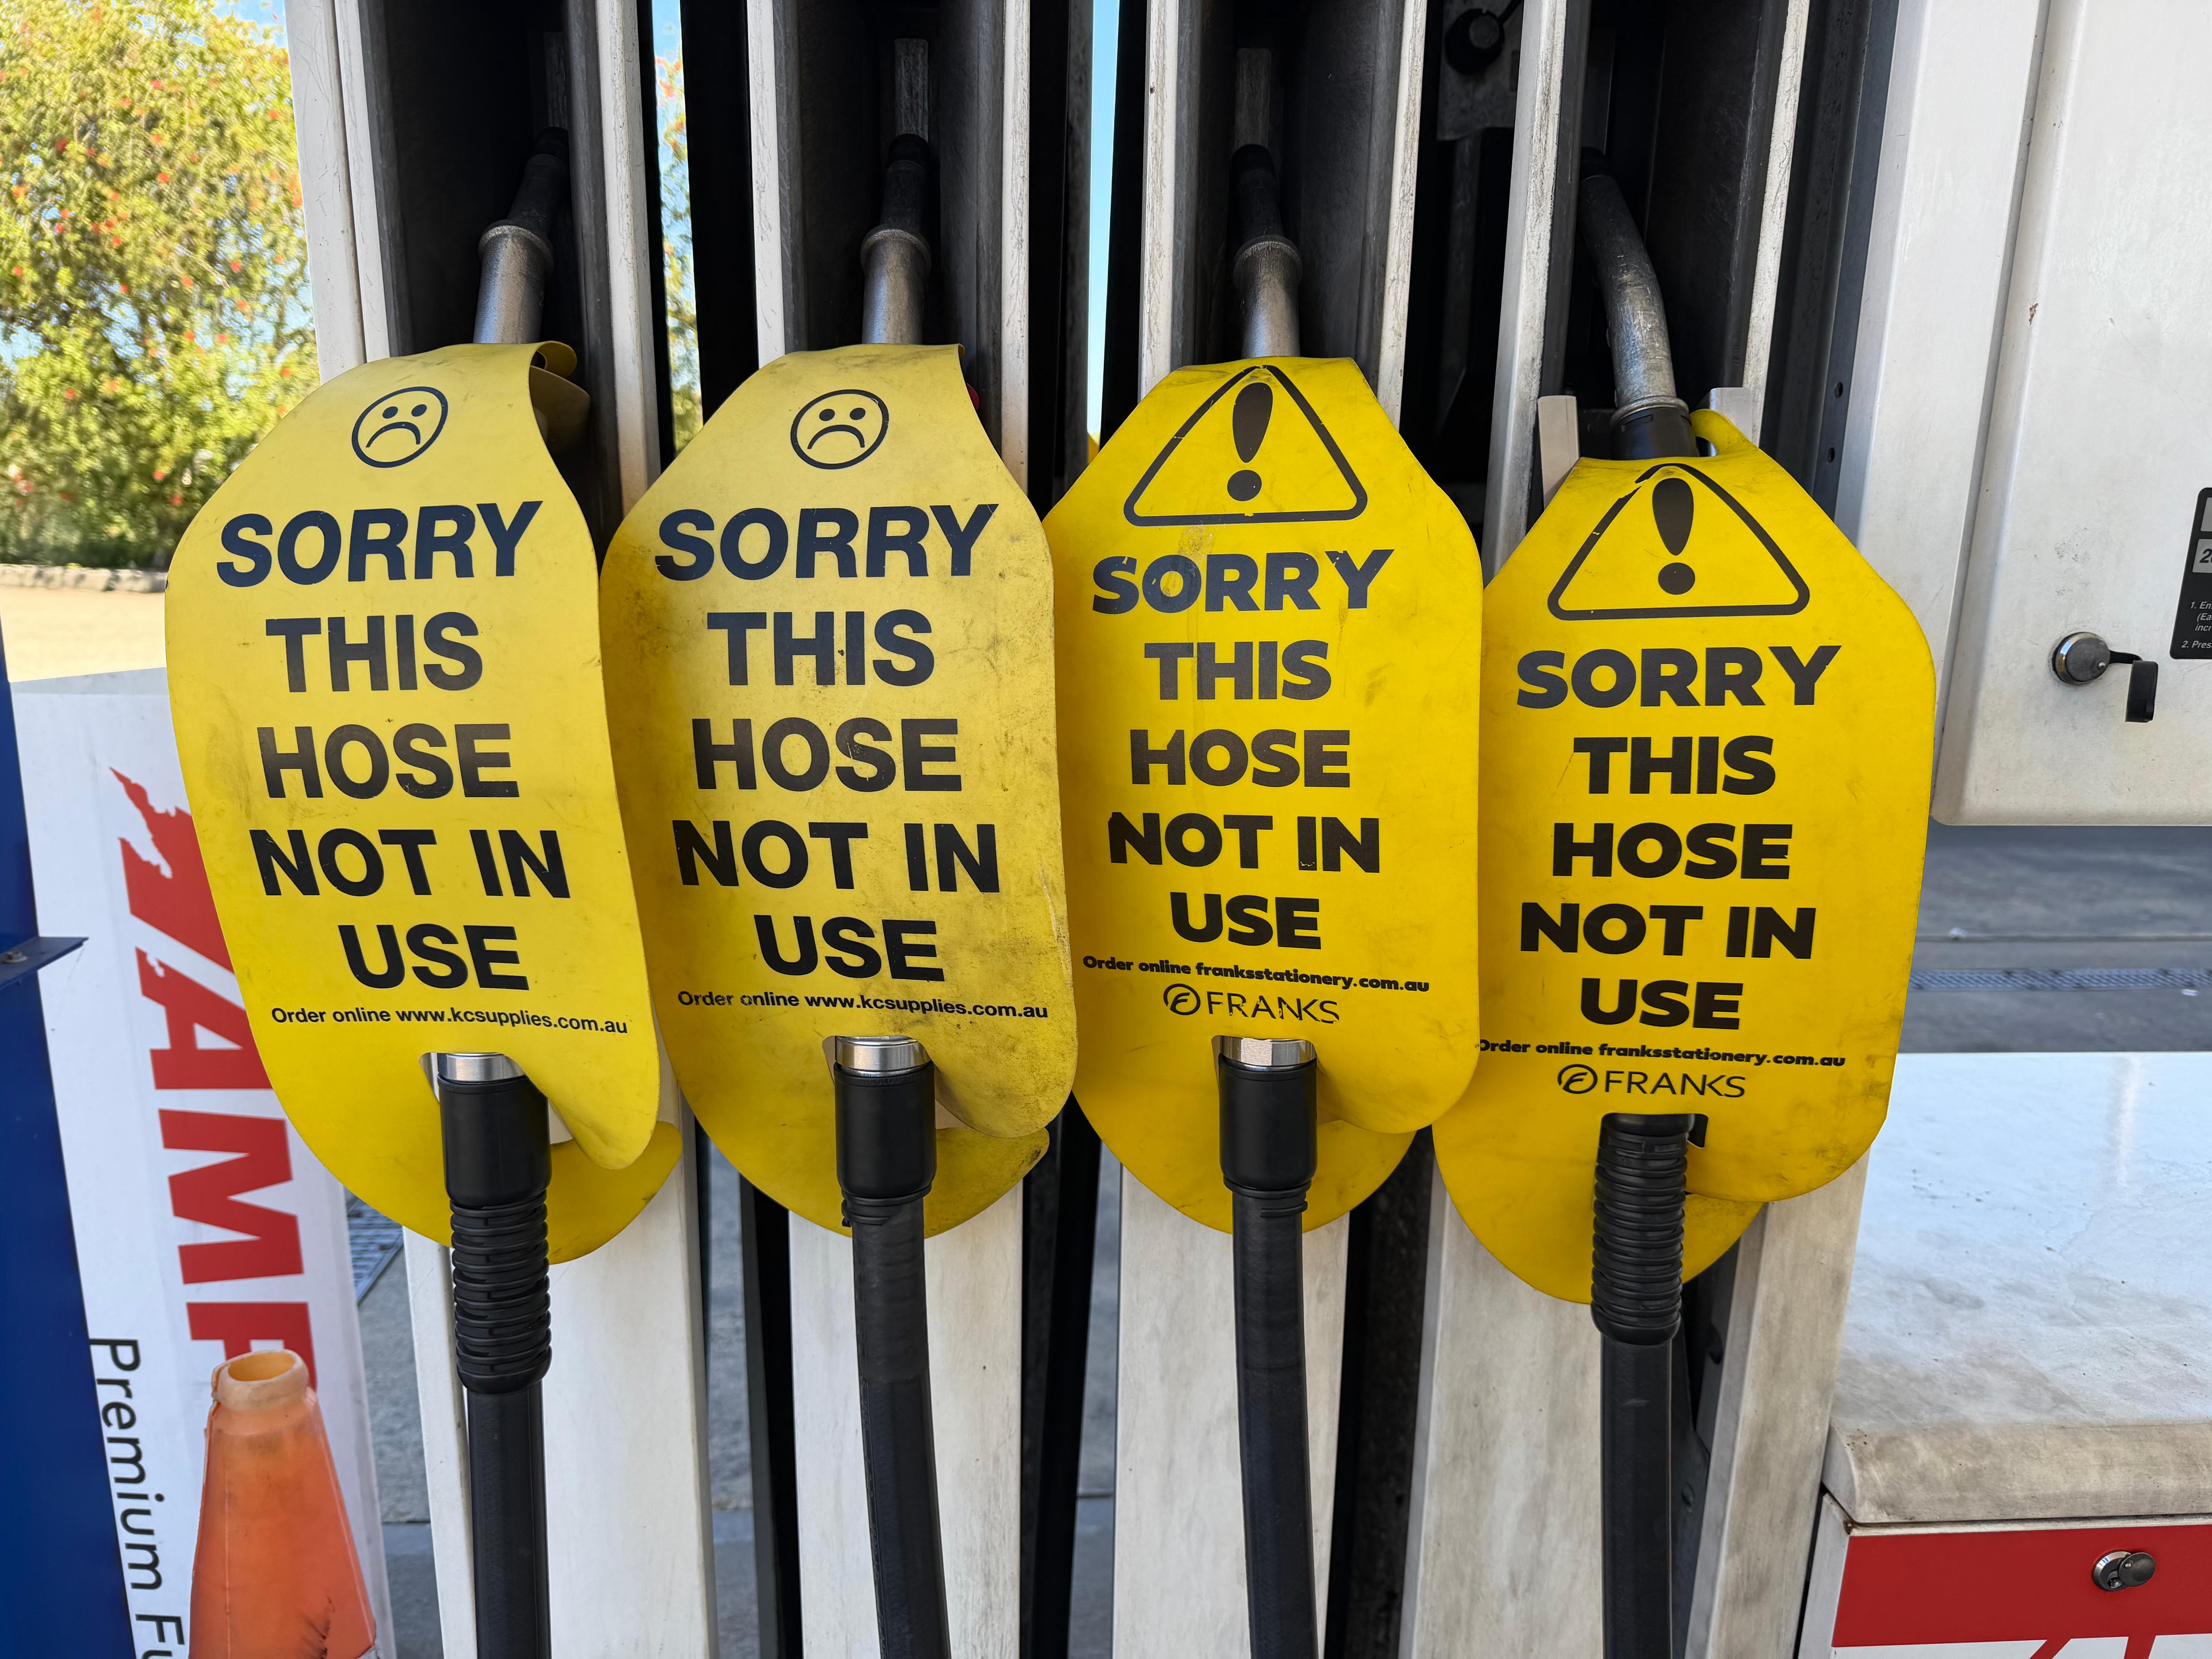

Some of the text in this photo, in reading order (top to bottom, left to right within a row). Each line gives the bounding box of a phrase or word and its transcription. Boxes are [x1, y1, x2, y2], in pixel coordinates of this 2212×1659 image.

[216, 500, 542, 587] SORRY
[655, 504, 998, 581] SORRY
[2199, 549, 2212, 563] 2
[1093, 549, 1394, 614] SORRY
[2197, 613, 2212, 622] (Ea
[266, 612, 482, 692] THIS
[707, 610, 934, 686] THIS
[1145, 640, 1331, 700] THIS
[1517, 646, 1841, 709] SORRY
[257, 723, 519, 799] HOSE
[692, 718, 961, 792] HOSE
[1130, 730, 1350, 787] HOSE
[1574, 736, 1775, 795] THIS
[250, 829, 570, 898] NOT IN
[672, 820, 999, 892] NOT IN
[1108, 812, 1379, 873] NOT IN
[1553, 823, 1792, 879] HOSE
[754, 915, 945, 982] USE
[1170, 892, 1321, 949] USE
[1521, 902, 1816, 959] NOT IN
[338, 924, 529, 990] USE
[1083, 956, 1429, 992] Order online franksstationery.com.au
[272, 1008, 627, 1033] Order online www.kcsupplies.com.au
[678, 991, 1048, 1018] Order online www.kcsupplies.com.au
[1207, 992, 1339, 1023] FRANKS
[1581, 978, 1743, 1029] USE
[1480, 1039, 1845, 1066] Order online franksstationery.com.au
[1605, 1071, 1745, 1097] FRANKS
[90, 1338, 165, 1590] Premium
